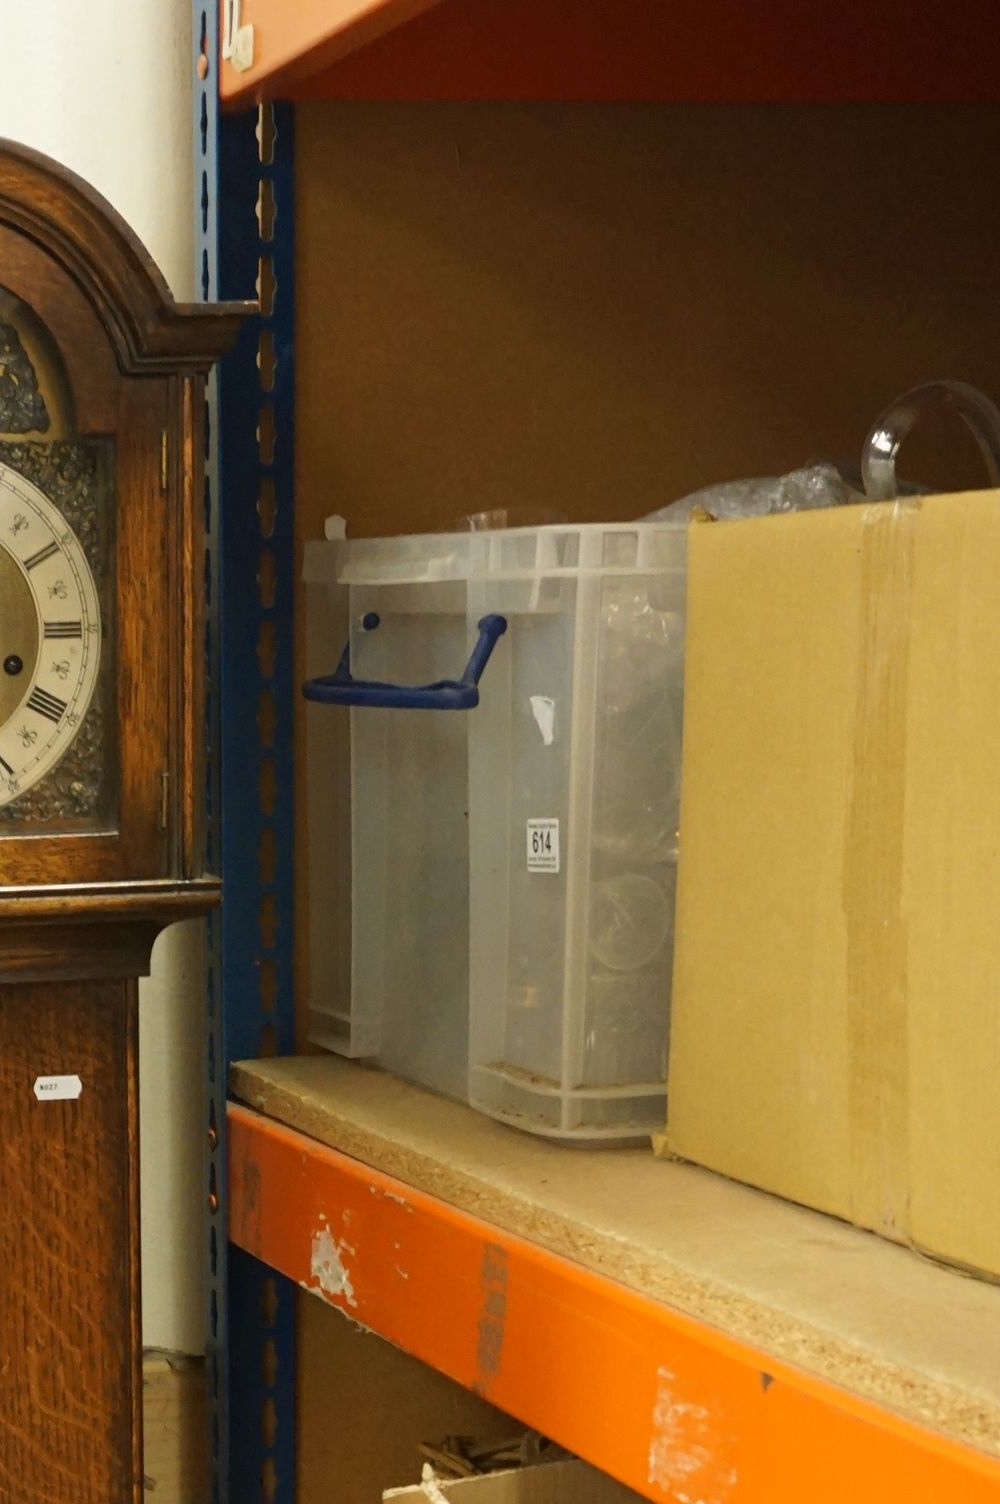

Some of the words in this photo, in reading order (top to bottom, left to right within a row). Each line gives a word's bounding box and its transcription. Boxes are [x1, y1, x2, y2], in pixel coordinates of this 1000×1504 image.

[23, 541, 60, 571] II
[43, 621, 82, 639] III
[26, 685, 68, 724] IIII
[532, 831, 551, 853] 614
